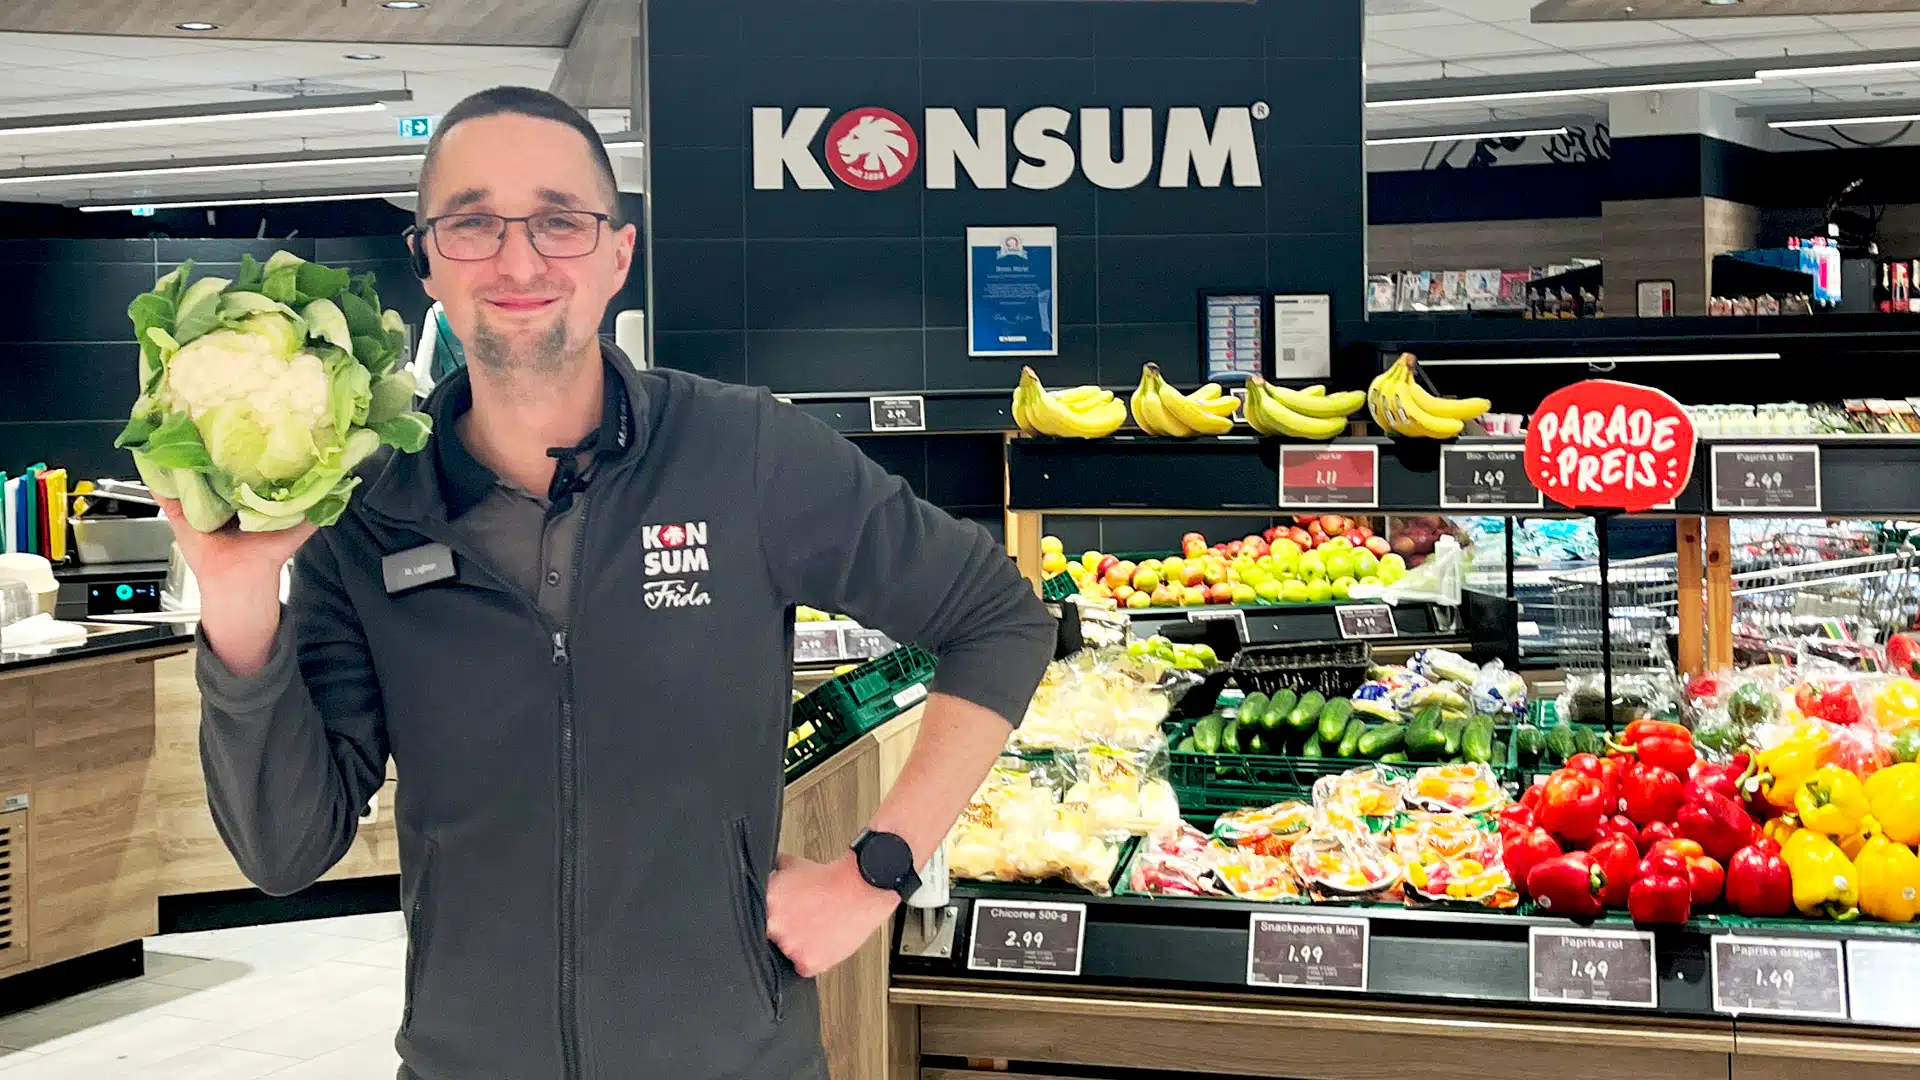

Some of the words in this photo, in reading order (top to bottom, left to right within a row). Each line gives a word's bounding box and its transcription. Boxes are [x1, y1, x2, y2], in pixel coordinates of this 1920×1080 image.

[752, 106, 1263, 191] KONSUM
[1538, 404, 1680, 453] PARADE
[1473, 470, 1505, 487] 1.49
[1556, 446, 1657, 493] PREIS
[1744, 471, 1782, 489] 2.49
[642, 521, 708, 549] KON
[644, 547, 710, 576] SUM
[643, 580, 712, 609] Frida
[990, 907, 1036, 920] Chicoree
[1260, 920, 1333, 936] Snackpaprika
[1004, 930, 1044, 949] 2.99
[1561, 936, 1605, 949] Paprika
[1608, 939, 1624, 950] rot
[1288, 944, 1323, 964] 1.99
[1732, 944, 1777, 957] Paprika
[1571, 958, 1609, 980] 1.49
[1756, 967, 1795, 989] 1.49
